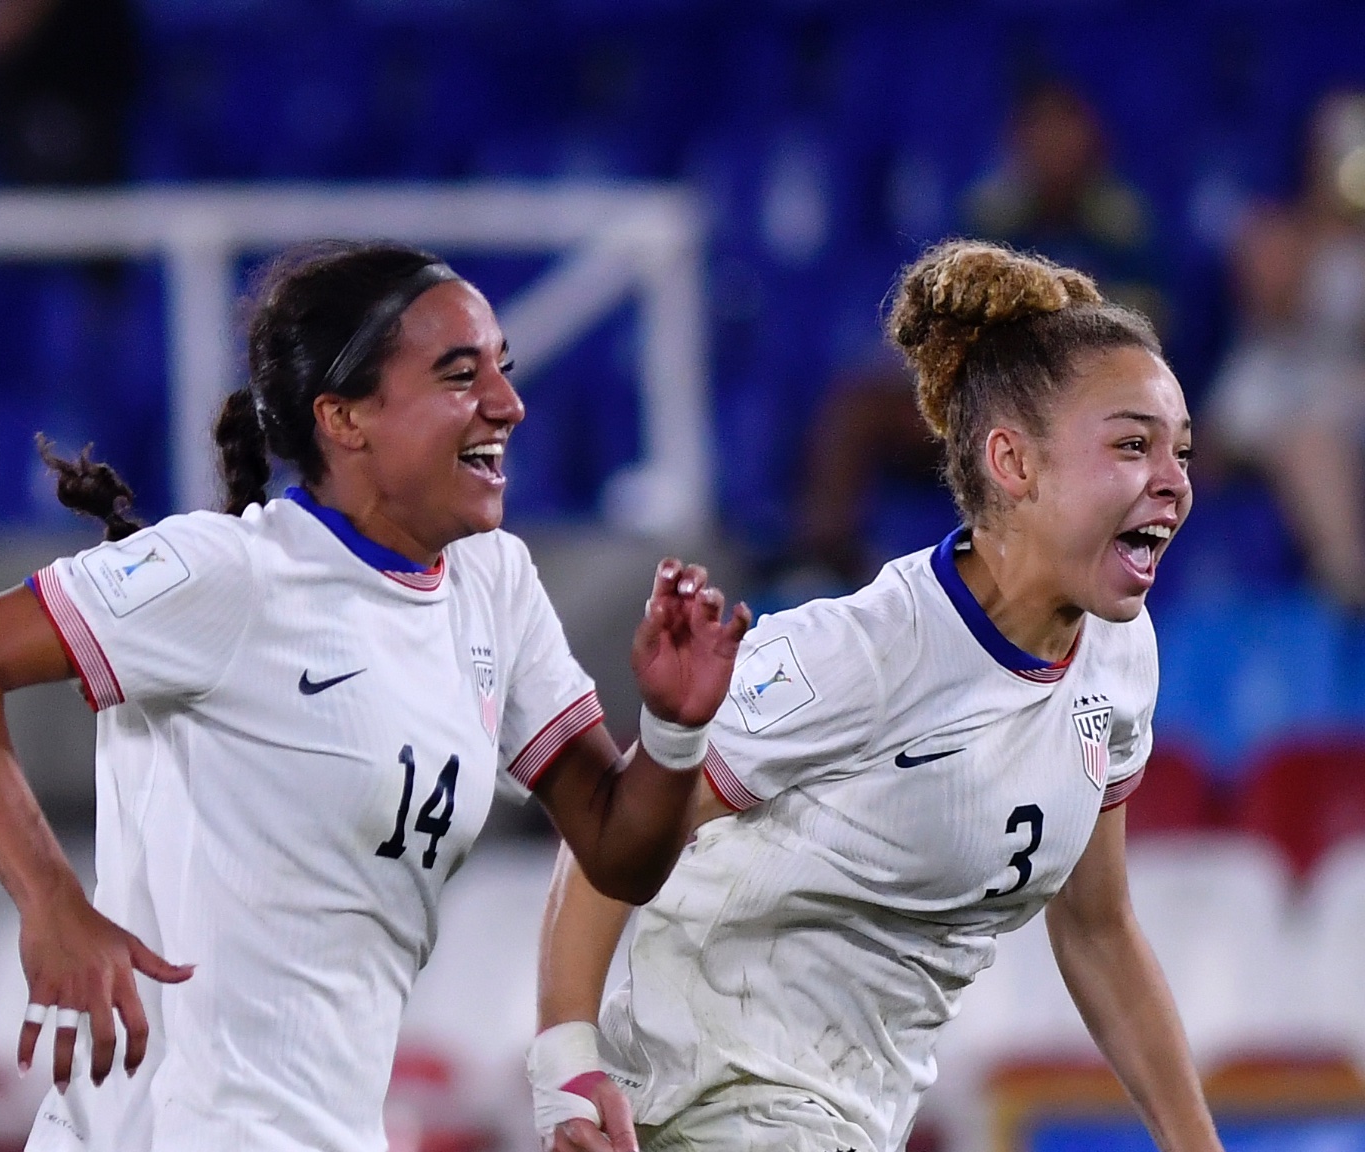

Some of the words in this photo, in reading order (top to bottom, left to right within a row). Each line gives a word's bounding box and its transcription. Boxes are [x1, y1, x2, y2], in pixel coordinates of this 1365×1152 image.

[1077, 712, 1109, 744] USA
[374, 743, 459, 869] 14
[982, 802, 1044, 900] 3
